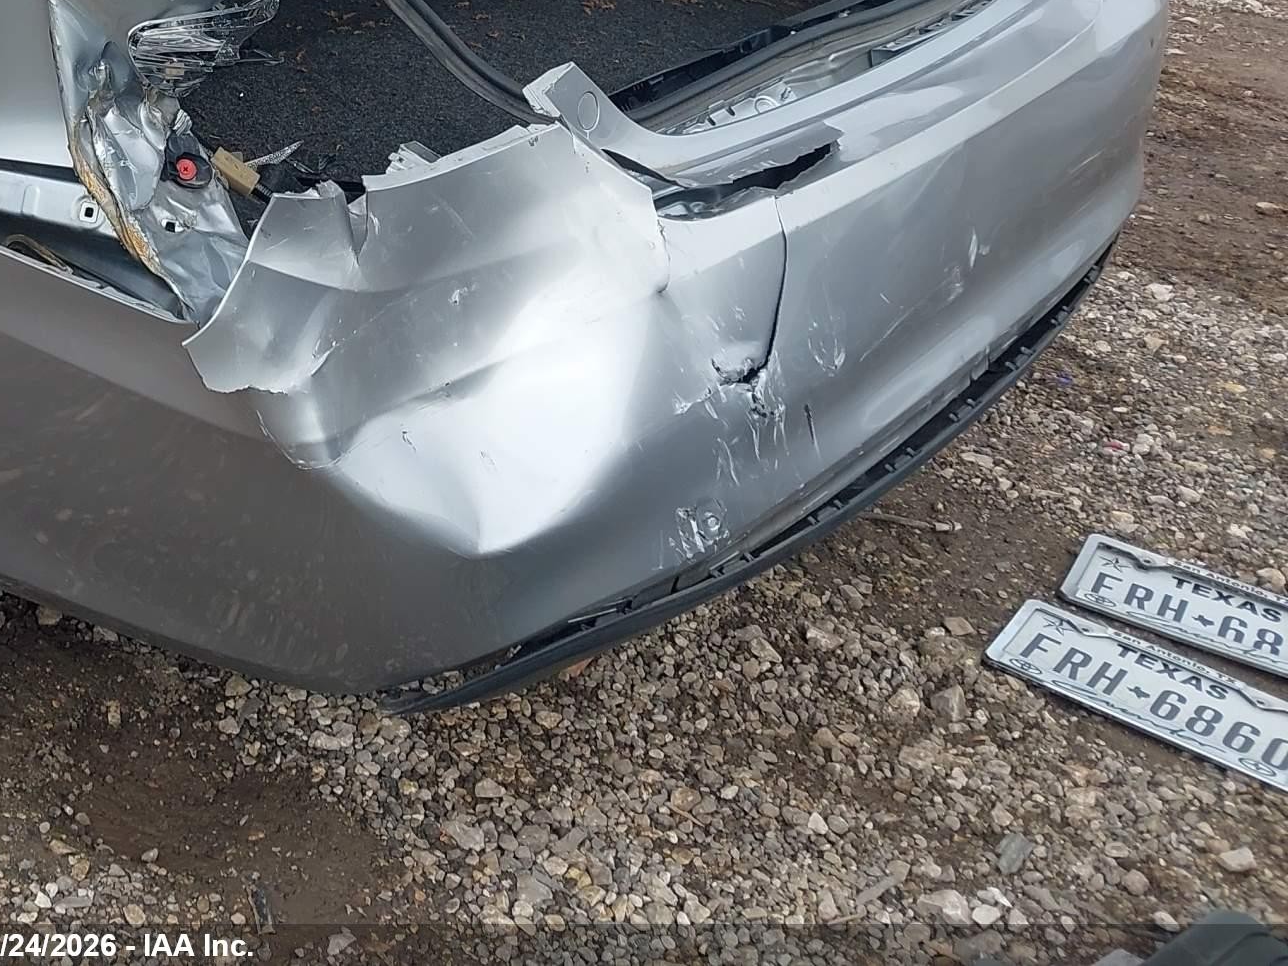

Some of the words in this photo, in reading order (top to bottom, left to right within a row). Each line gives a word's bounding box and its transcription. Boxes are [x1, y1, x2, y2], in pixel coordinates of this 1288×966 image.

[1090, 572, 1189, 623] FRH
[1172, 575, 1283, 623] TEXAS
[1019, 631, 1129, 696] FRH
[1117, 643, 1230, 701] TEXAS
